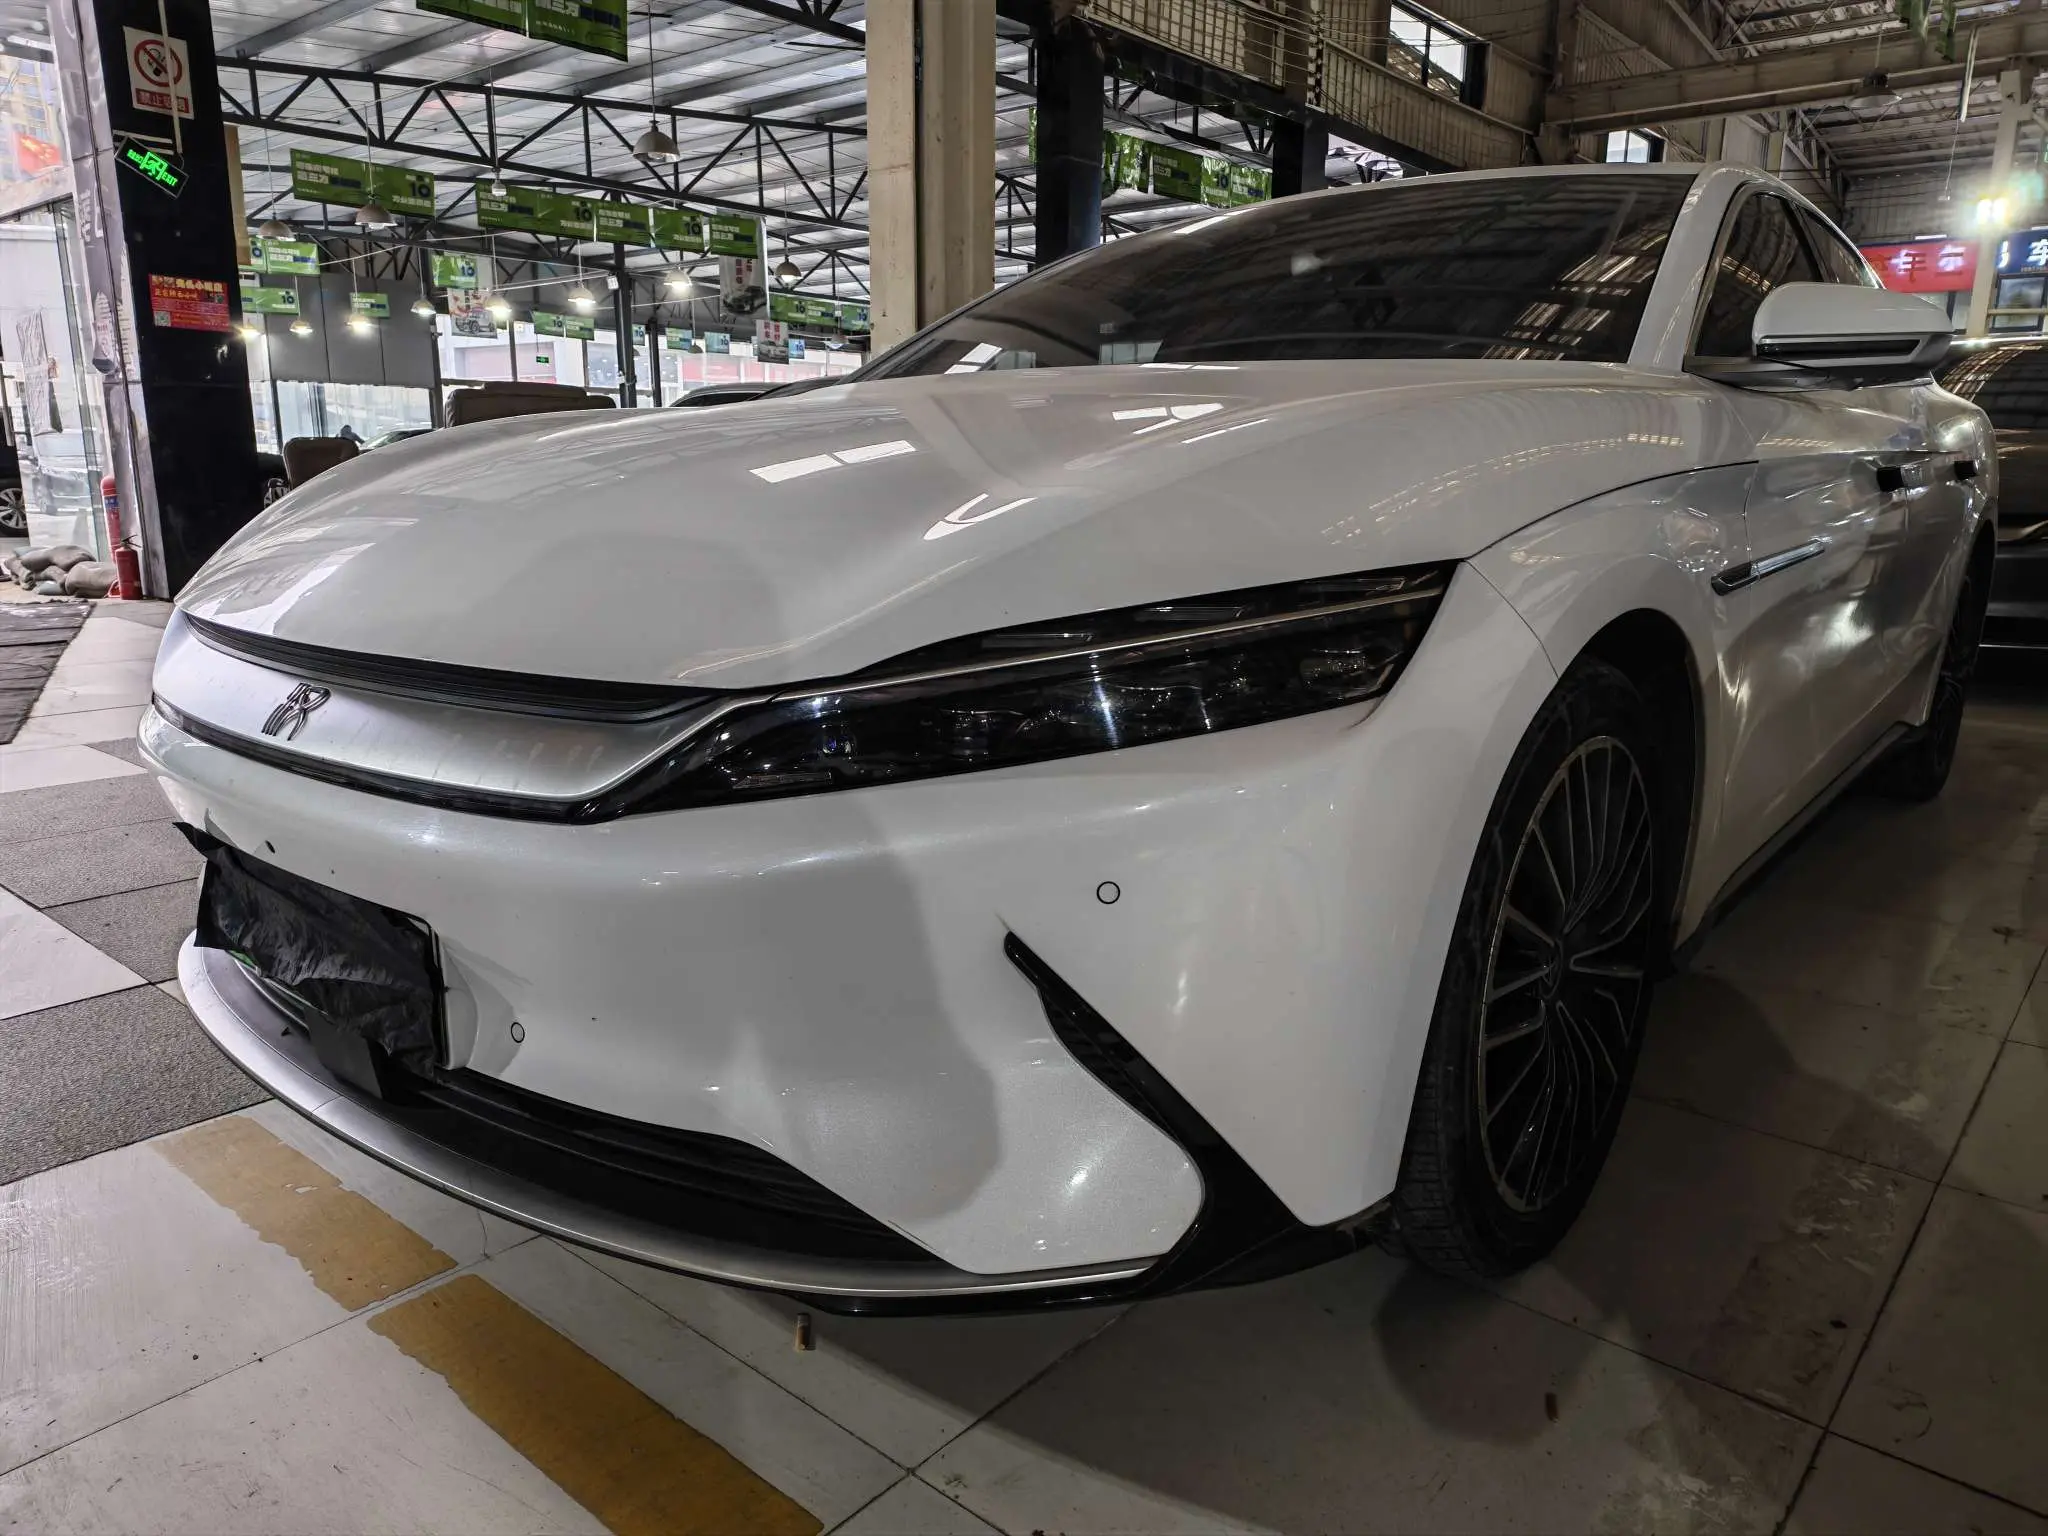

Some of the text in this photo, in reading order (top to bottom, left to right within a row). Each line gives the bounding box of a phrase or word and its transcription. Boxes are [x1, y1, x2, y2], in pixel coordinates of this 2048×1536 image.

[161, 171, 178, 186] EXIT
[410, 181, 430, 198] 10
[574, 207, 592, 222] 10
[684, 222, 701, 235] 10
[461, 265, 475, 277] 10
[282, 295, 294, 304] 10
[553, 320, 563, 328] 10
